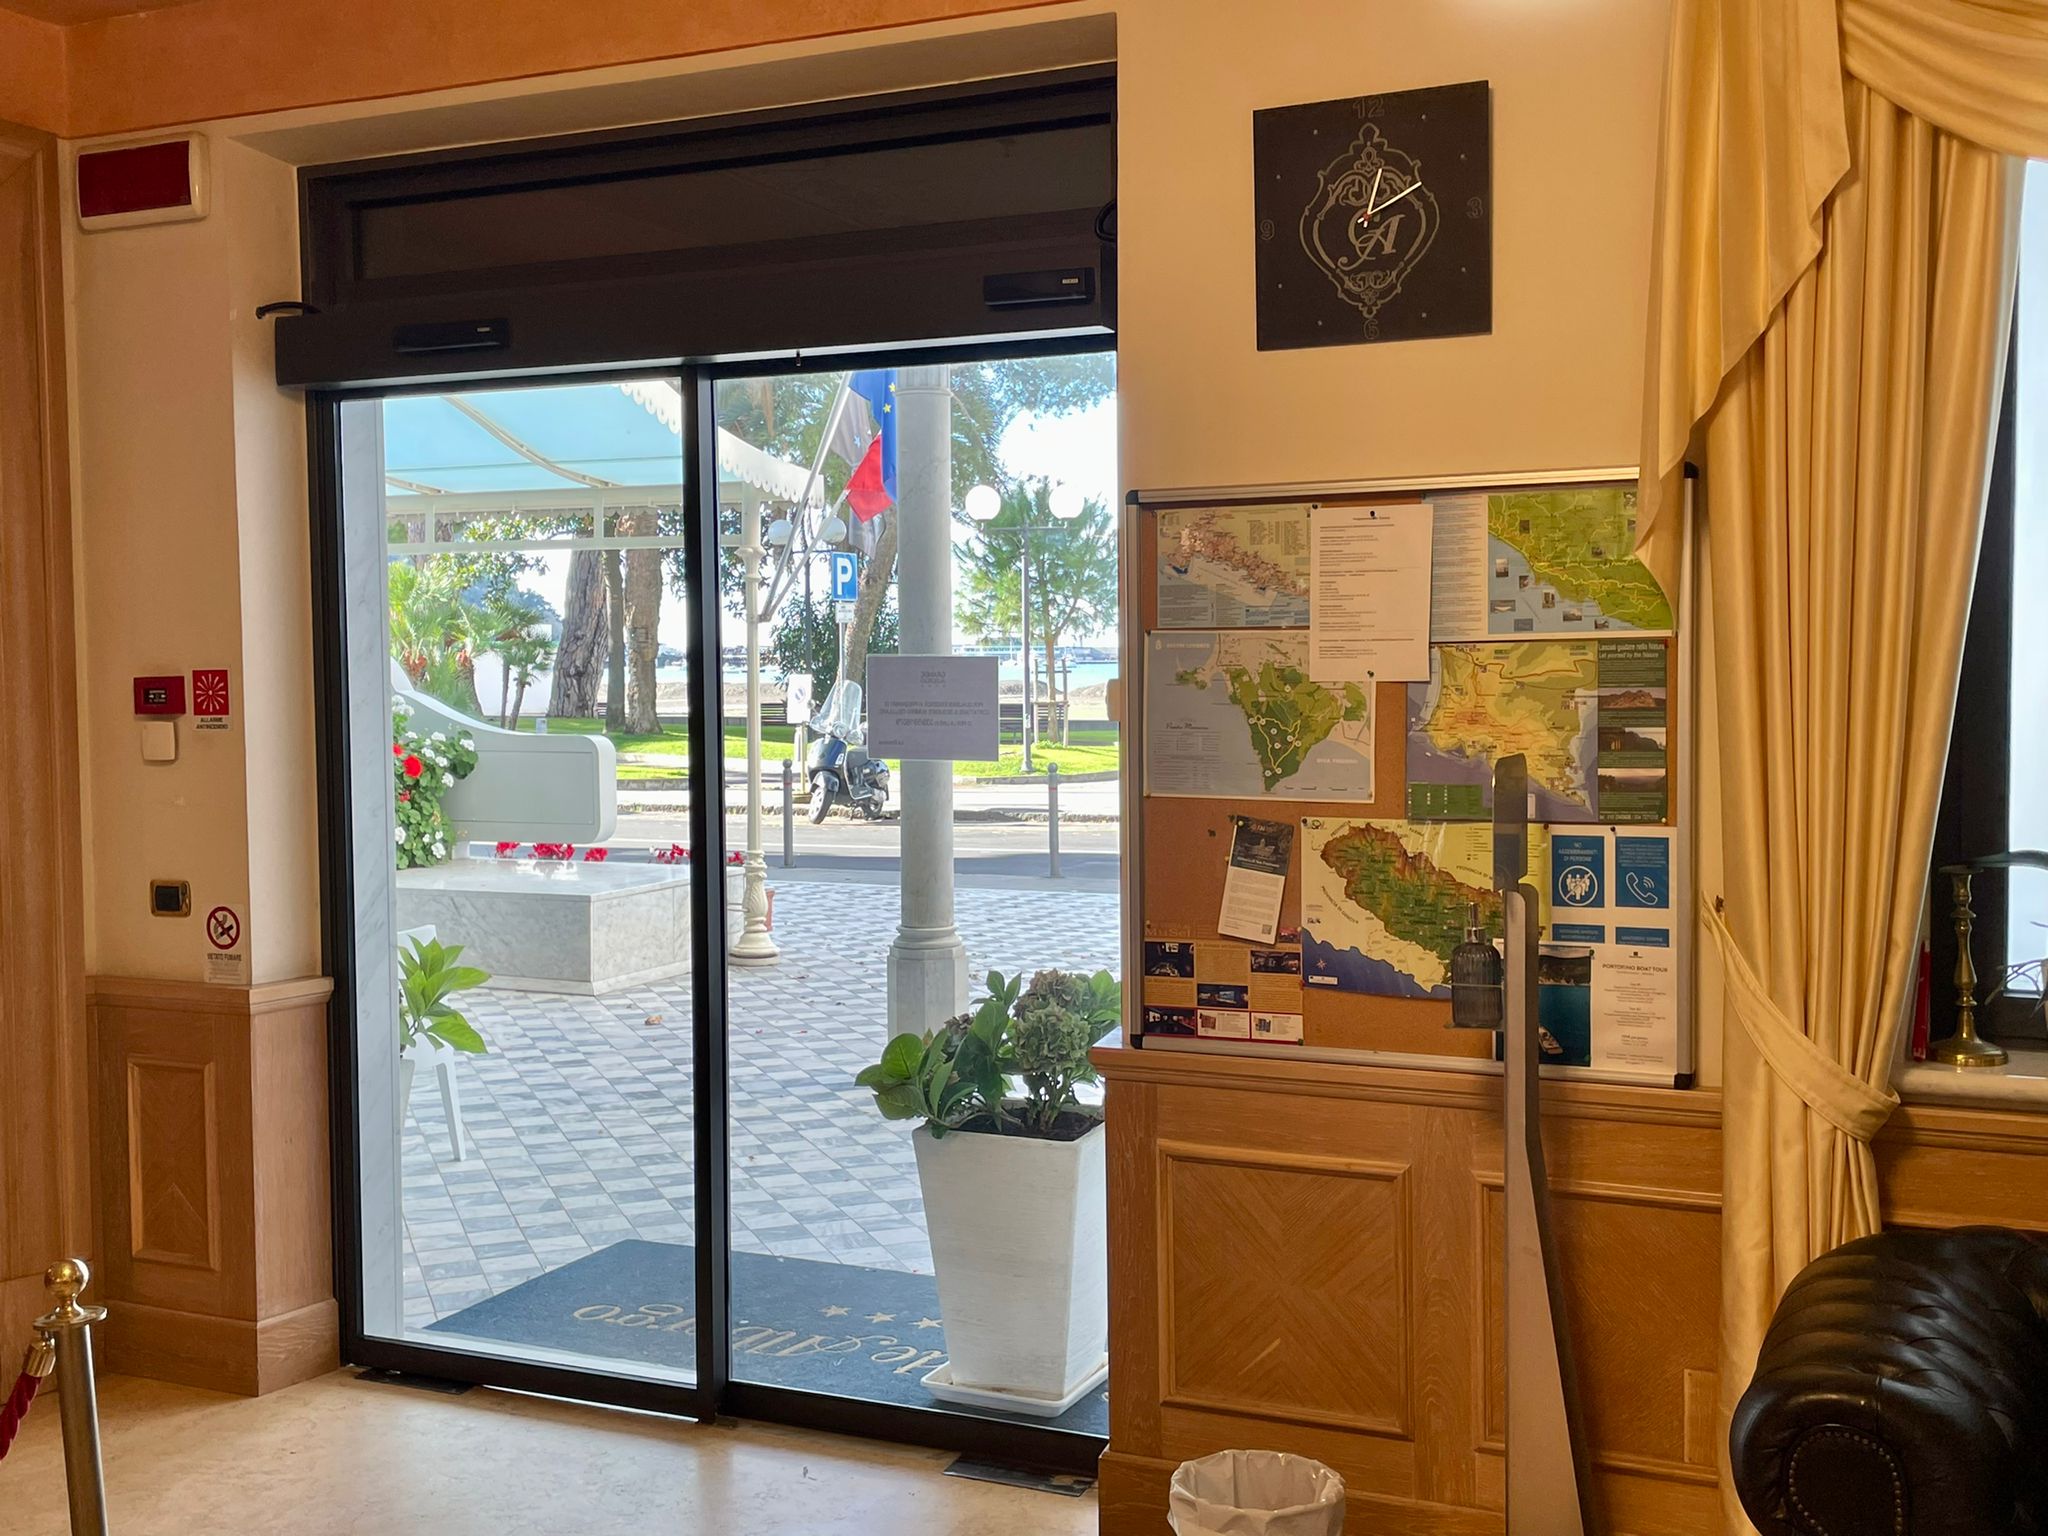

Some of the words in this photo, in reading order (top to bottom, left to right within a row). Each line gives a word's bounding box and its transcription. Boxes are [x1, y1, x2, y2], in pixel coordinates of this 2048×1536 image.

[1353, 97, 1385, 119] 12
[1466, 197, 1484, 218] 3
[1259, 219, 1275, 240] 9
[1363, 318, 1380, 340] 6
[837, 557, 853, 596] P
